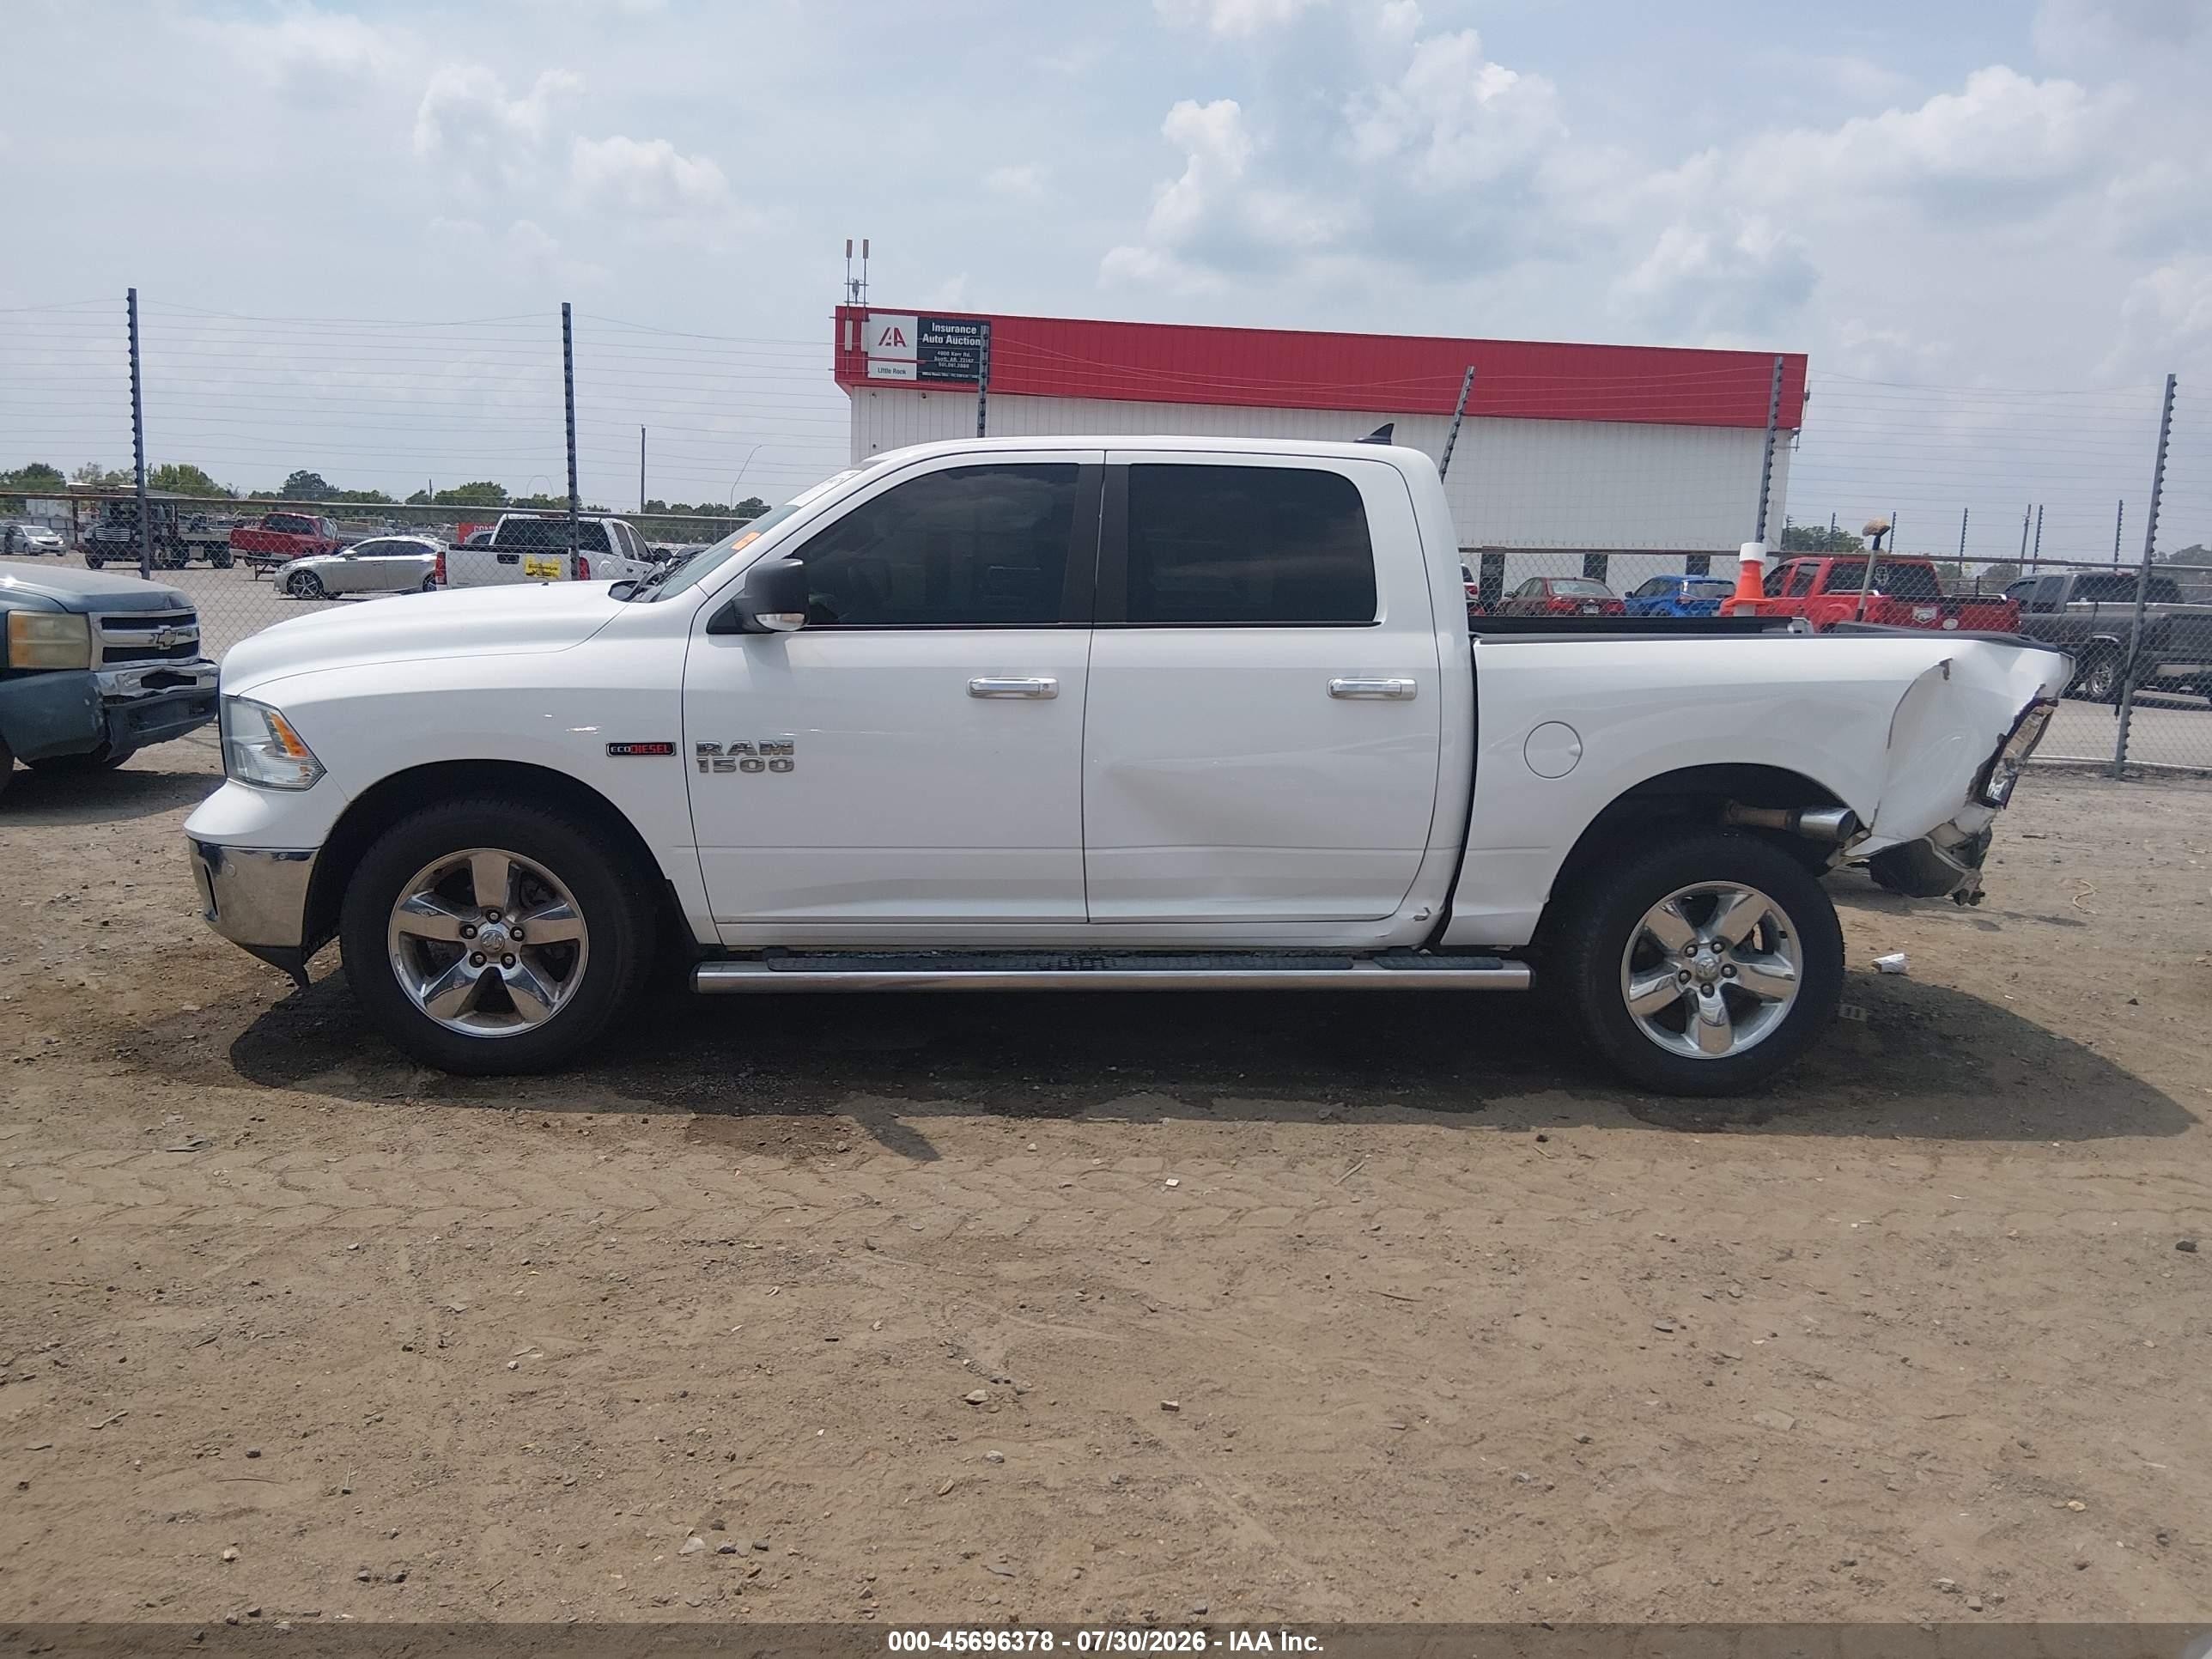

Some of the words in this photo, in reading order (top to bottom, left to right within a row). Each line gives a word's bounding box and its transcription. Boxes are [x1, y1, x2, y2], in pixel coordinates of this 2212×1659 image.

[932, 322, 976, 334] Insurance
[922, 333, 944, 343] Auto
[945, 335, 981, 346] Auction
[611, 744, 671, 754] ECODIESEL
[696, 740, 794, 756] RAM
[696, 757, 794, 773] 1500
